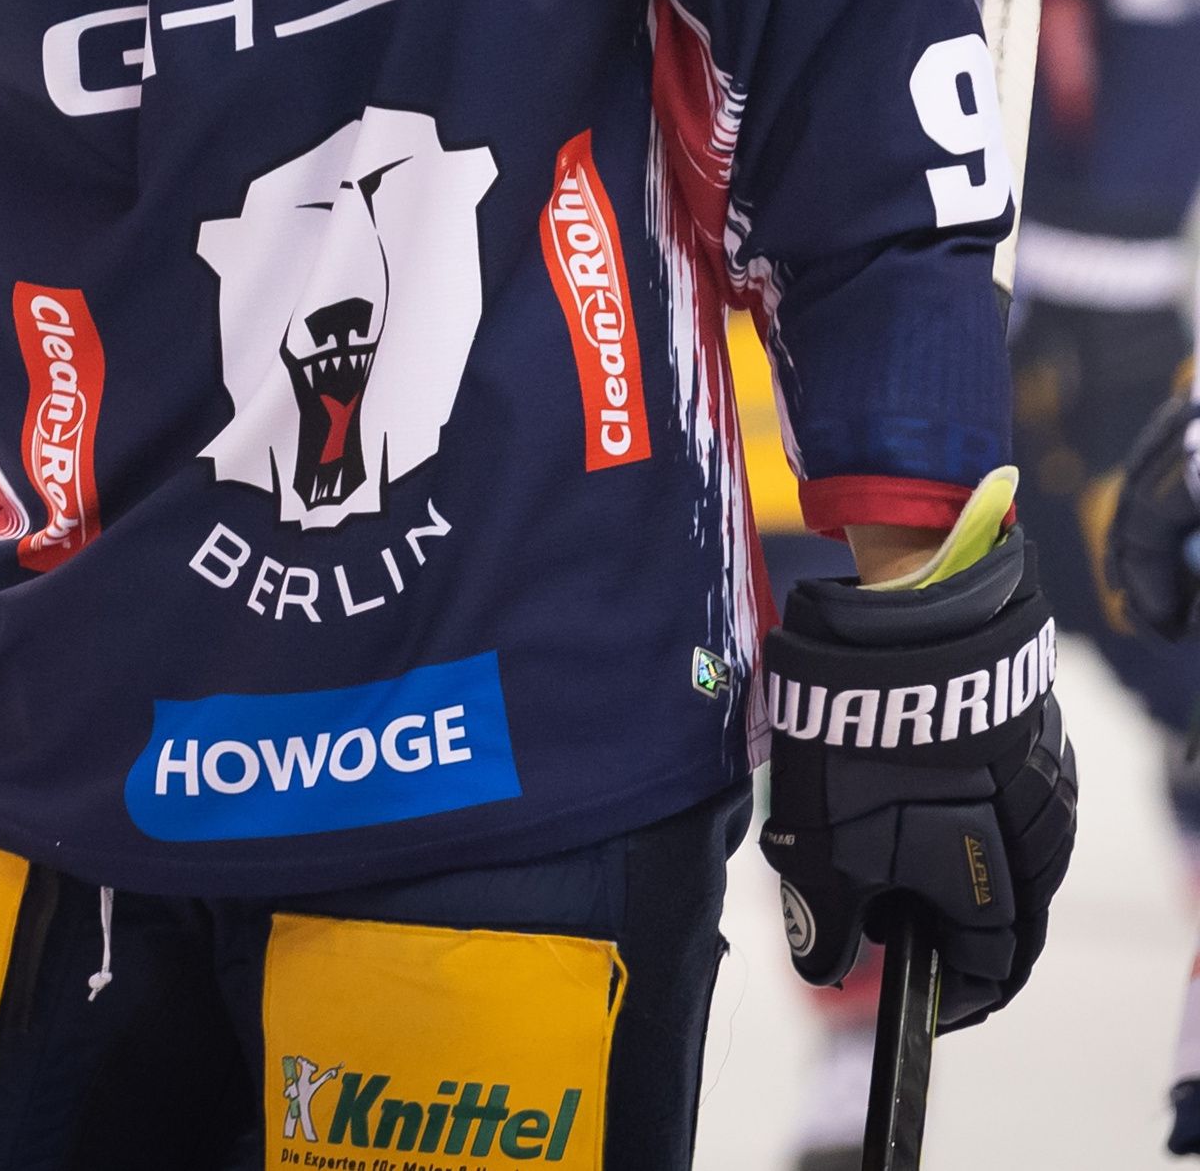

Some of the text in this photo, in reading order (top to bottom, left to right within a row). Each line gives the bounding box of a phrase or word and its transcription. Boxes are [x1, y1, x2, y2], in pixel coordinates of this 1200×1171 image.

[188, 498, 452, 623] BERLIN
[769, 616, 1057, 748] WARRIOR
[155, 704, 472, 796] HOWOGE
[281, 1148, 300, 1164] Die
[304, 1151, 366, 1171] Experten
[328, 1072, 582, 1161] Knittel
